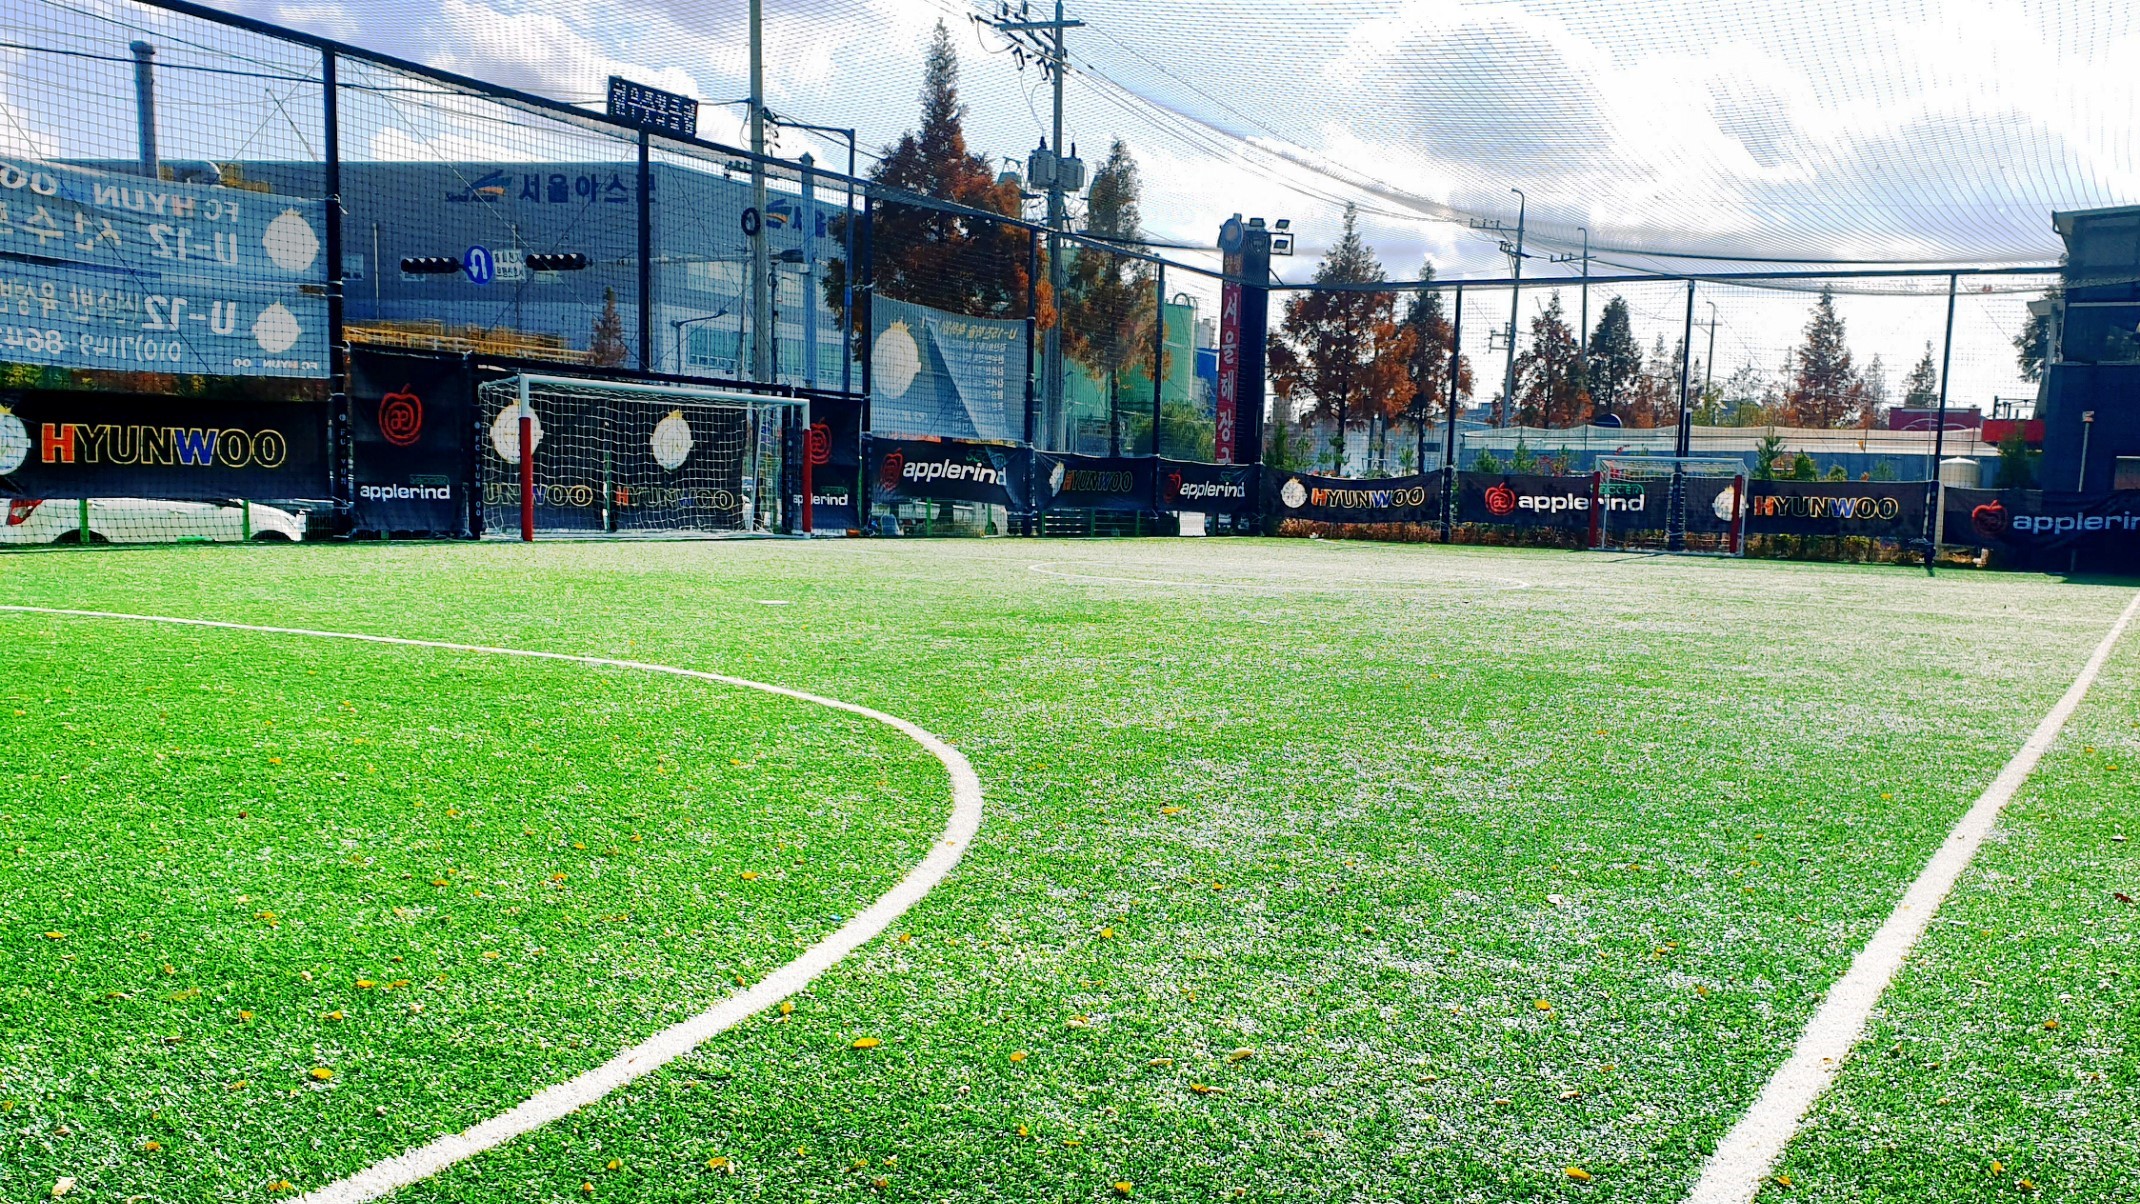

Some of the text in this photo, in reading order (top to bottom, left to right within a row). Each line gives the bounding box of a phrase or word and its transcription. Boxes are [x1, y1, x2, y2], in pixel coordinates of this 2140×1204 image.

[42, 422, 286, 467] HYUNWOO
[903, 458, 1007, 486] applerind
[1062, 469, 1133, 493] HYUNWOO
[360, 484, 450, 502] applerind
[615, 486, 734, 510] HYUNWOO
[792, 493, 849, 507] aplerind
[1180, 481, 1245, 500] applerind
[1311, 487, 1425, 509] HYUNWOO
[1754, 496, 1899, 520] HYUNWOO
[2013, 511, 2140, 534] applerin
